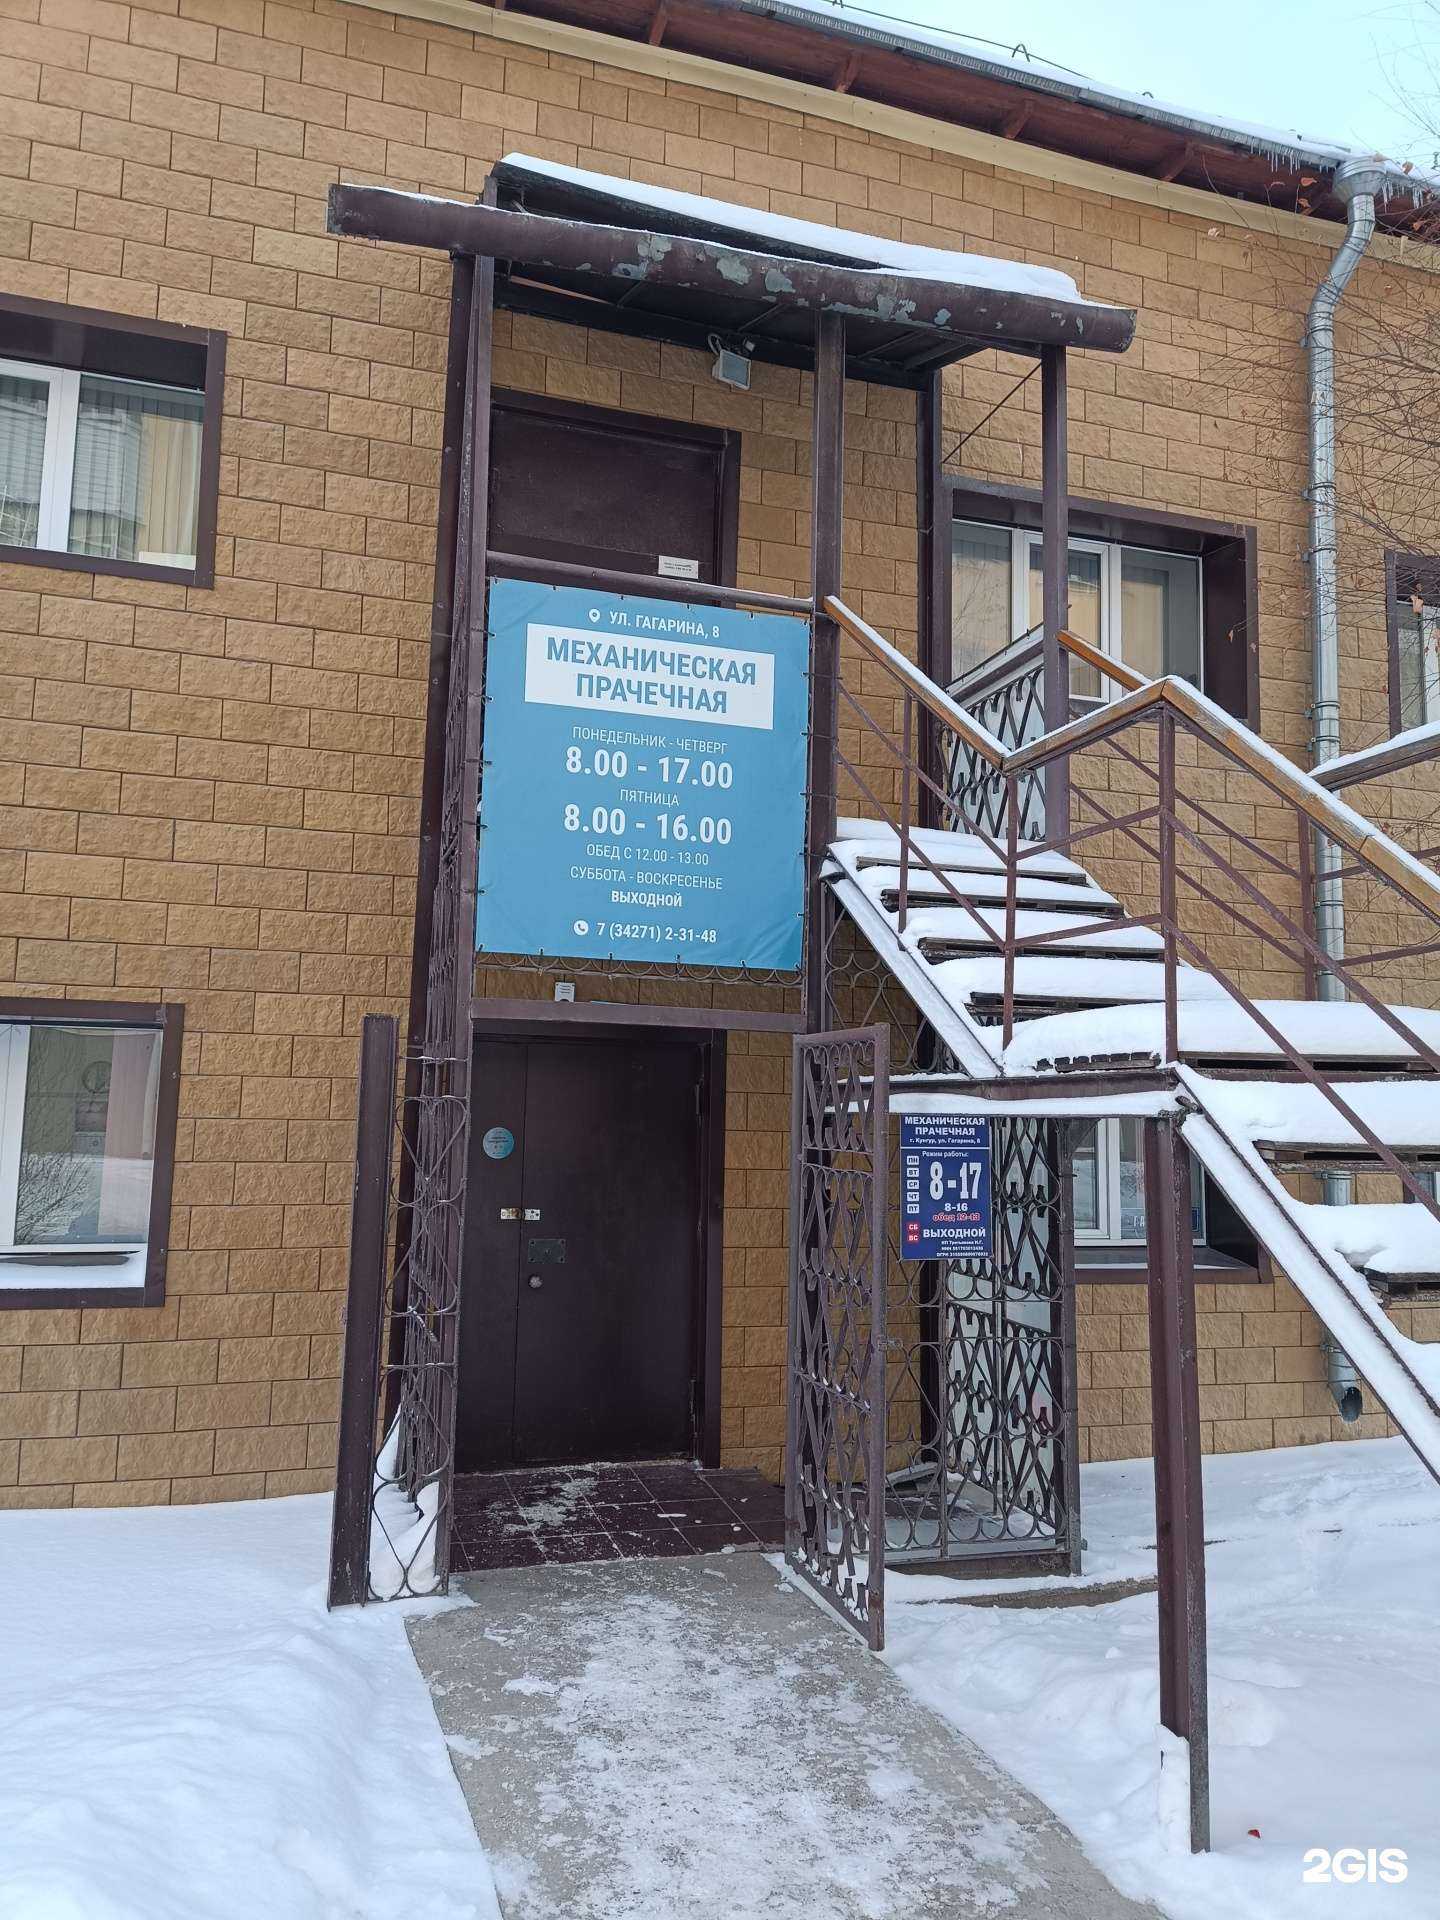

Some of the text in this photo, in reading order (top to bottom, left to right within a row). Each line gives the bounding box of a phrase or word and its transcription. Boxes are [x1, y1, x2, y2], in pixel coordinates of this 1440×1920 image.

[609, 610, 720, 639] УЛ. ГАГАРИНА, 8
[546, 636, 756, 685] МЕХАНИЧЕСКАЯ
[576, 673, 728, 714] ПРАЧЕЧНАЯ
[572, 726, 666, 747] ПОНЕДЕЛЬНИК
[676, 738, 728, 754] ЧЕТВЕРГ
[566, 746, 628, 777] 8.00
[658, 756, 733, 789] 17.00
[620, 789, 680, 807] ПЯТНИЦА
[564, 803, 626, 836] 8.00
[657, 813, 732, 844] 16.00
[586, 844, 620, 860] ОБЕД
[623, 847, 632, 859] С
[636, 848, 667, 863] 12.00
[678, 851, 709, 865] 13.00
[570, 866, 626, 882] СУББОТА
[637, 872, 723, 890] ВОСКРЕСЕНЬЕ
[611, 891, 682, 908] ВЫХОДНОЙ
[597, 923, 717, 943] 7 (34271) 2-31-48
[904, 1116, 985, 1126] МЕХАНИЧЕСКАЯ
[915, 1127, 975, 1136] ПРАЧЕЧНАЯ
[929, 1161, 982, 1200] 8-17
[944, 1202, 968, 1212] 8-16
[923, 1227, 986, 1239] ВЫХОДНОЙ
